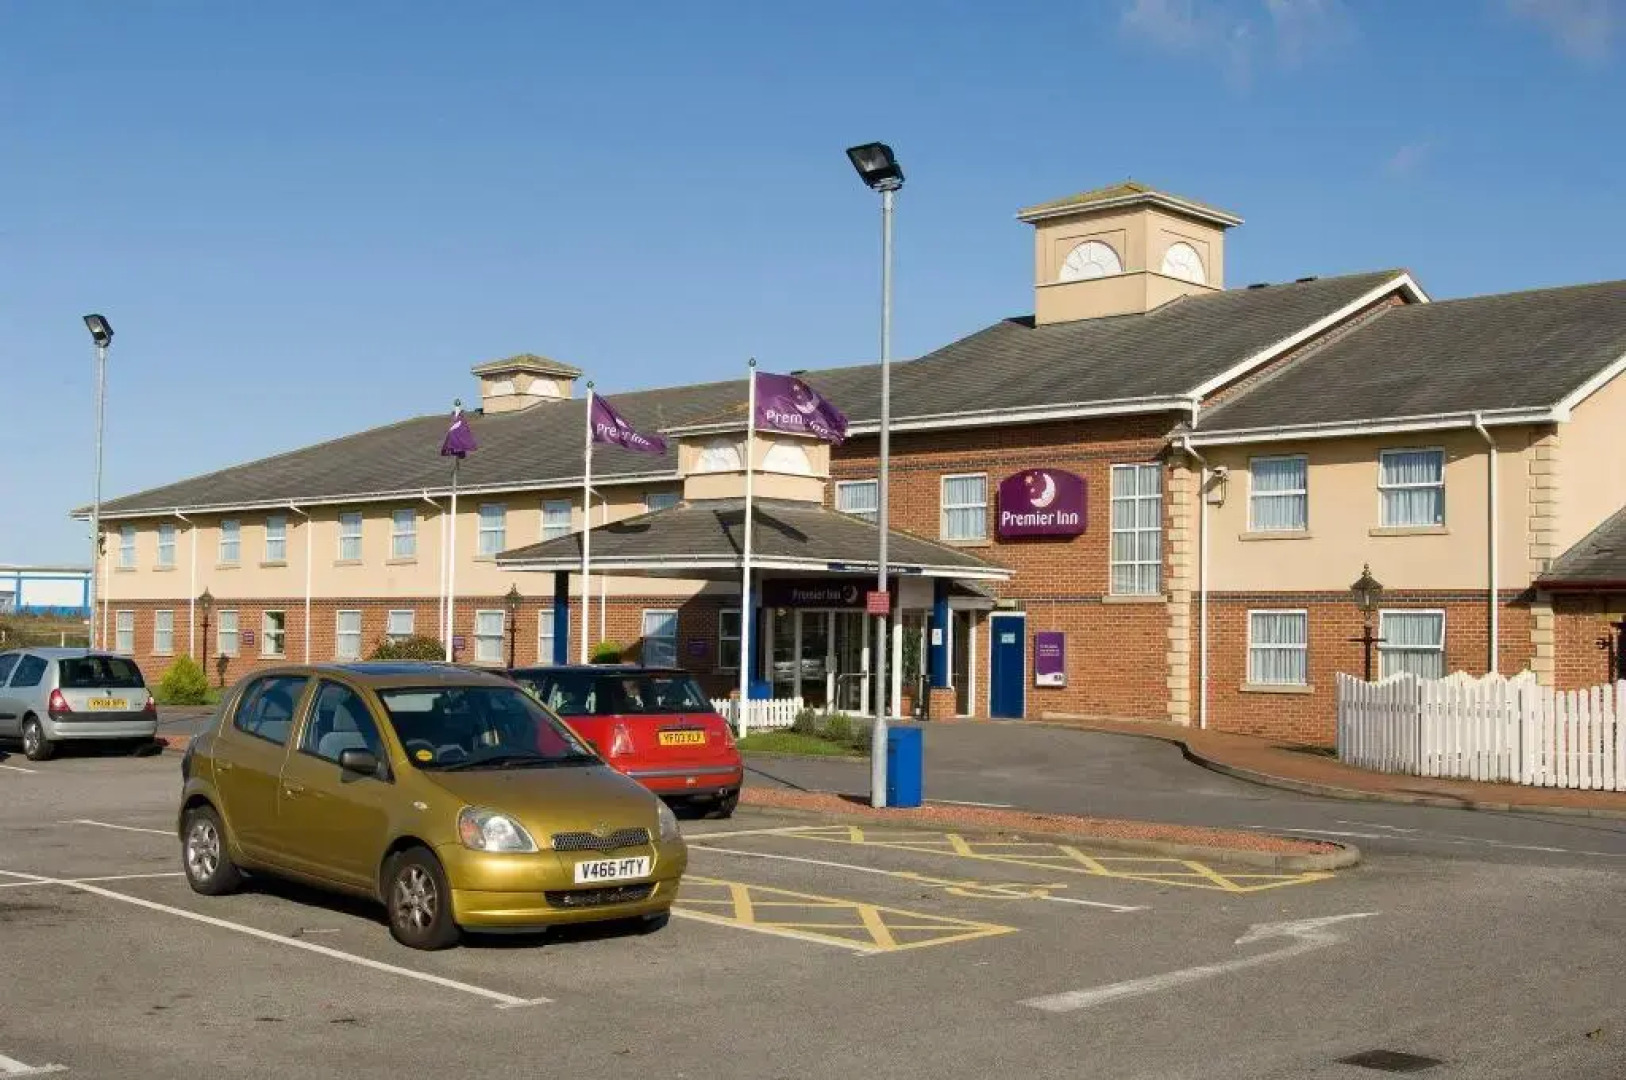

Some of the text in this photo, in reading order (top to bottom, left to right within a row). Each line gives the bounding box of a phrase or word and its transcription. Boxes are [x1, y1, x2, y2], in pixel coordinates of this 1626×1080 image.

[1001, 509, 1079, 527] Premier Inn
[582, 858, 643, 879] V466 HTY
